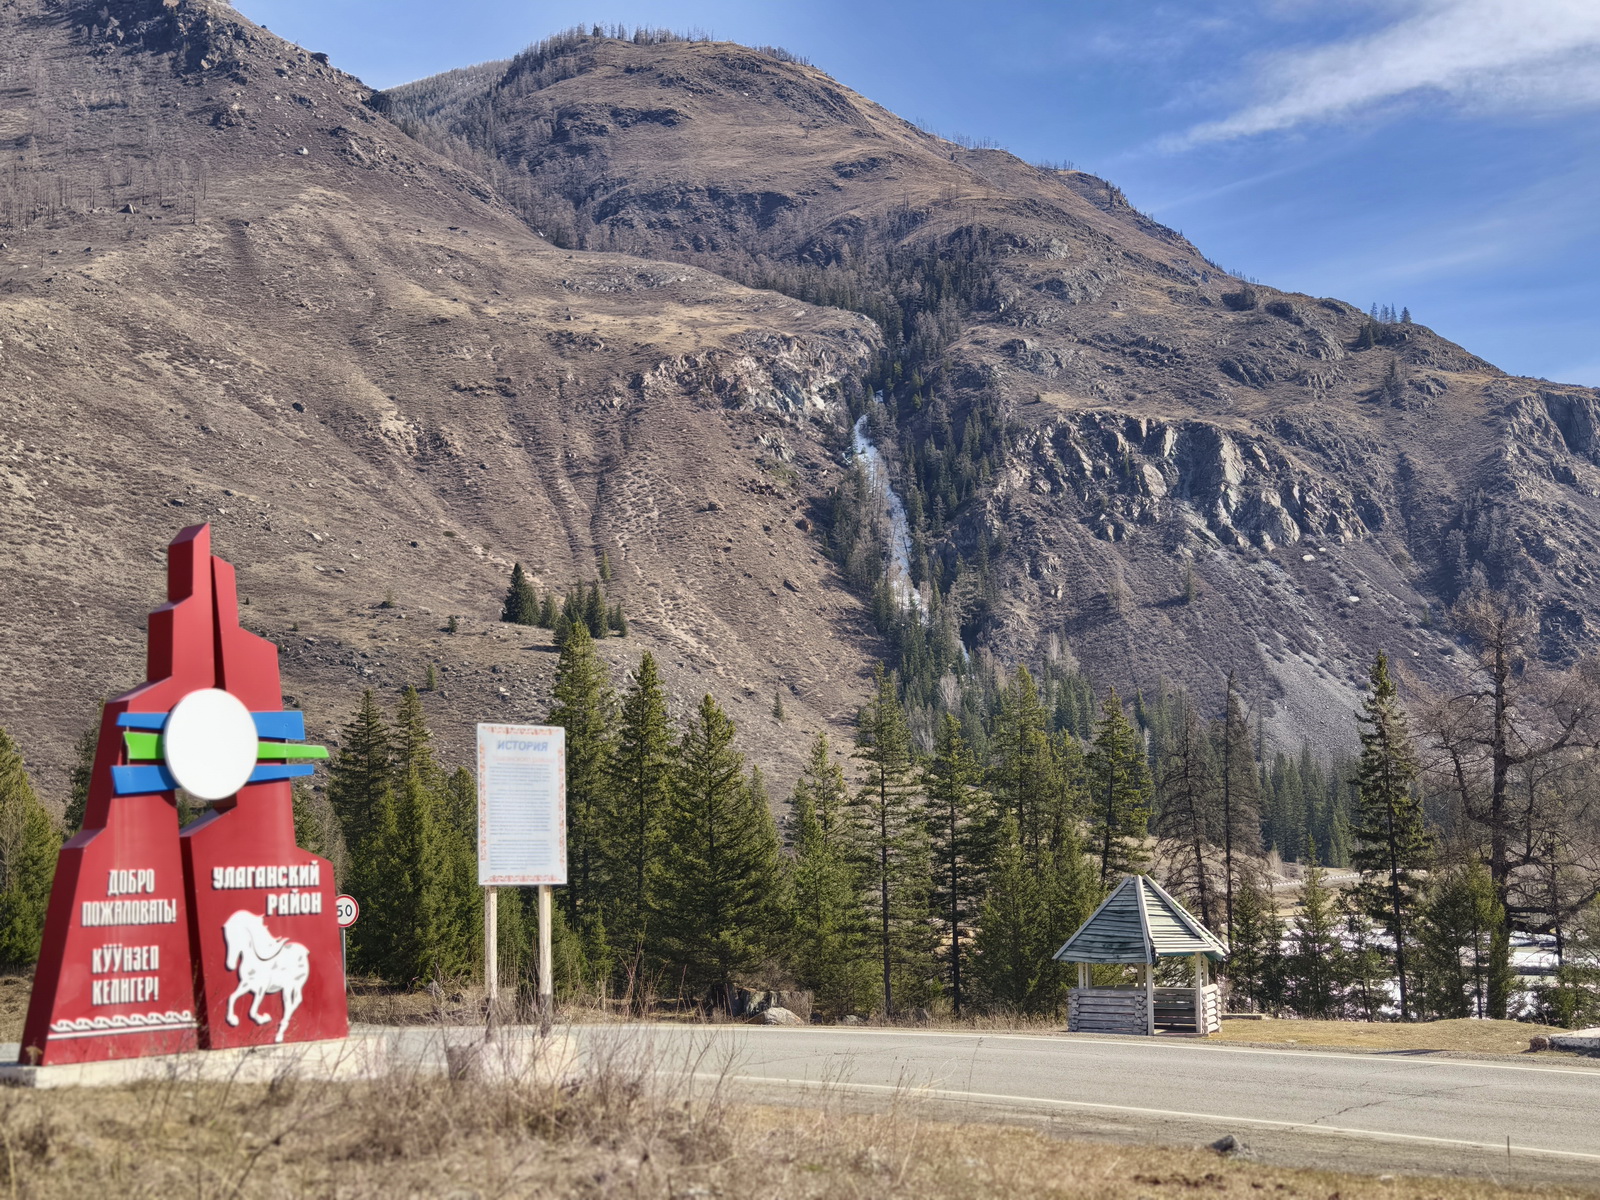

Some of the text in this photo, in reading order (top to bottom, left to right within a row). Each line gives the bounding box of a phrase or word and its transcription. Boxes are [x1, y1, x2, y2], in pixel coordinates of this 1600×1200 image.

[497, 740, 549, 751] ИСТОРИЯ
[107, 868, 155, 896] ДОБРО
[212, 860, 319, 889] УЛАГАНСКИЙ
[82, 898, 176, 927] ПОЖАЛОВАТЬ!
[266, 888, 322, 915] РАЙОН
[337, 904, 353, 917] 50
